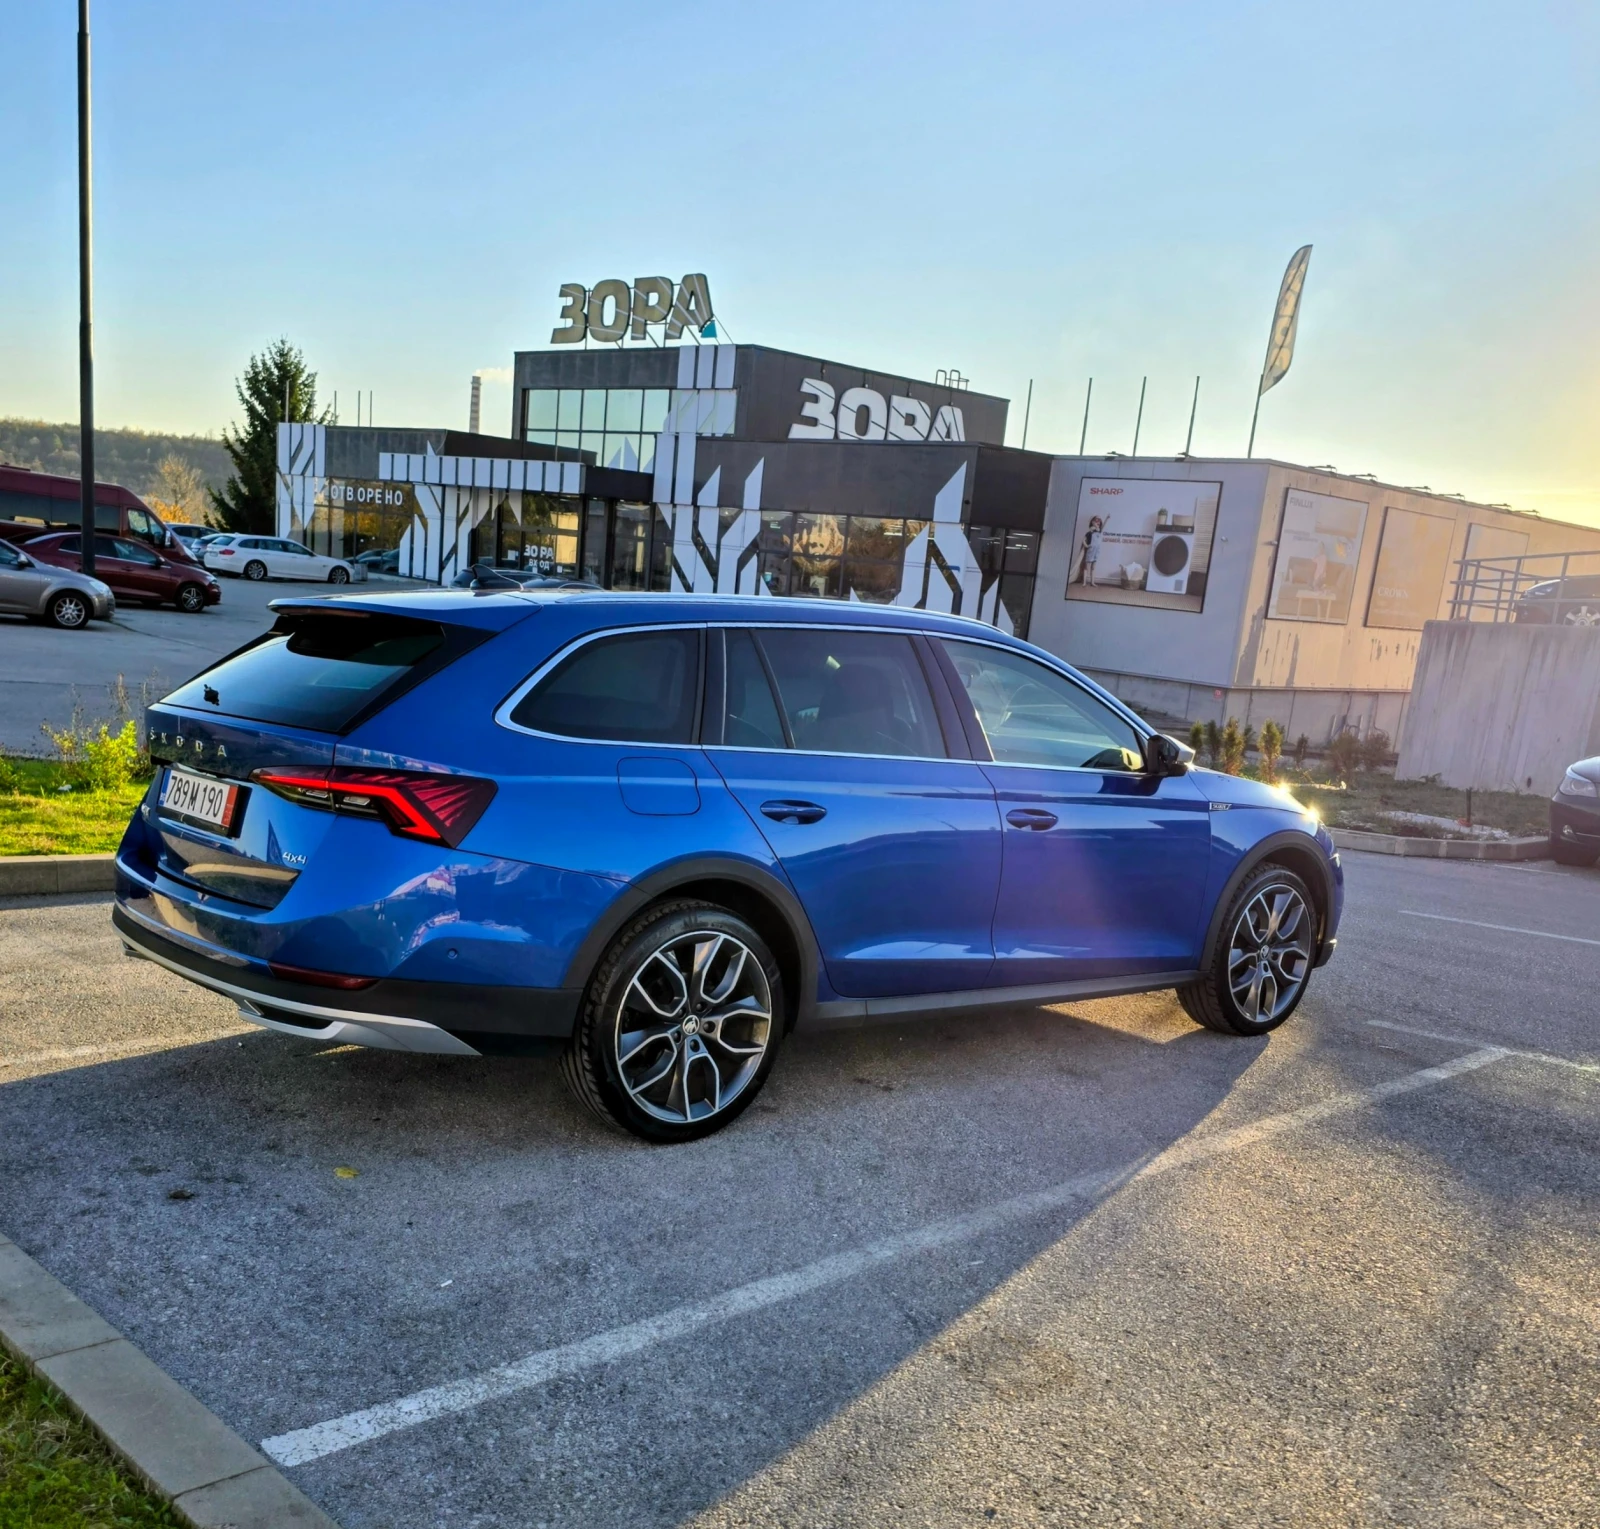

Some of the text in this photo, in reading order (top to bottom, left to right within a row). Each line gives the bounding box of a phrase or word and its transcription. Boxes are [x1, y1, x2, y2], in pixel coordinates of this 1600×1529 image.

[550, 273, 715, 344] ЗОРА
[787, 377, 966, 442] ЗОРА
[1090, 487, 1124, 496] SHARP
[1289, 497, 1314, 509] FINLUX
[1377, 586, 1409, 599] CROWN
[282, 851, 307, 865] 4x4
